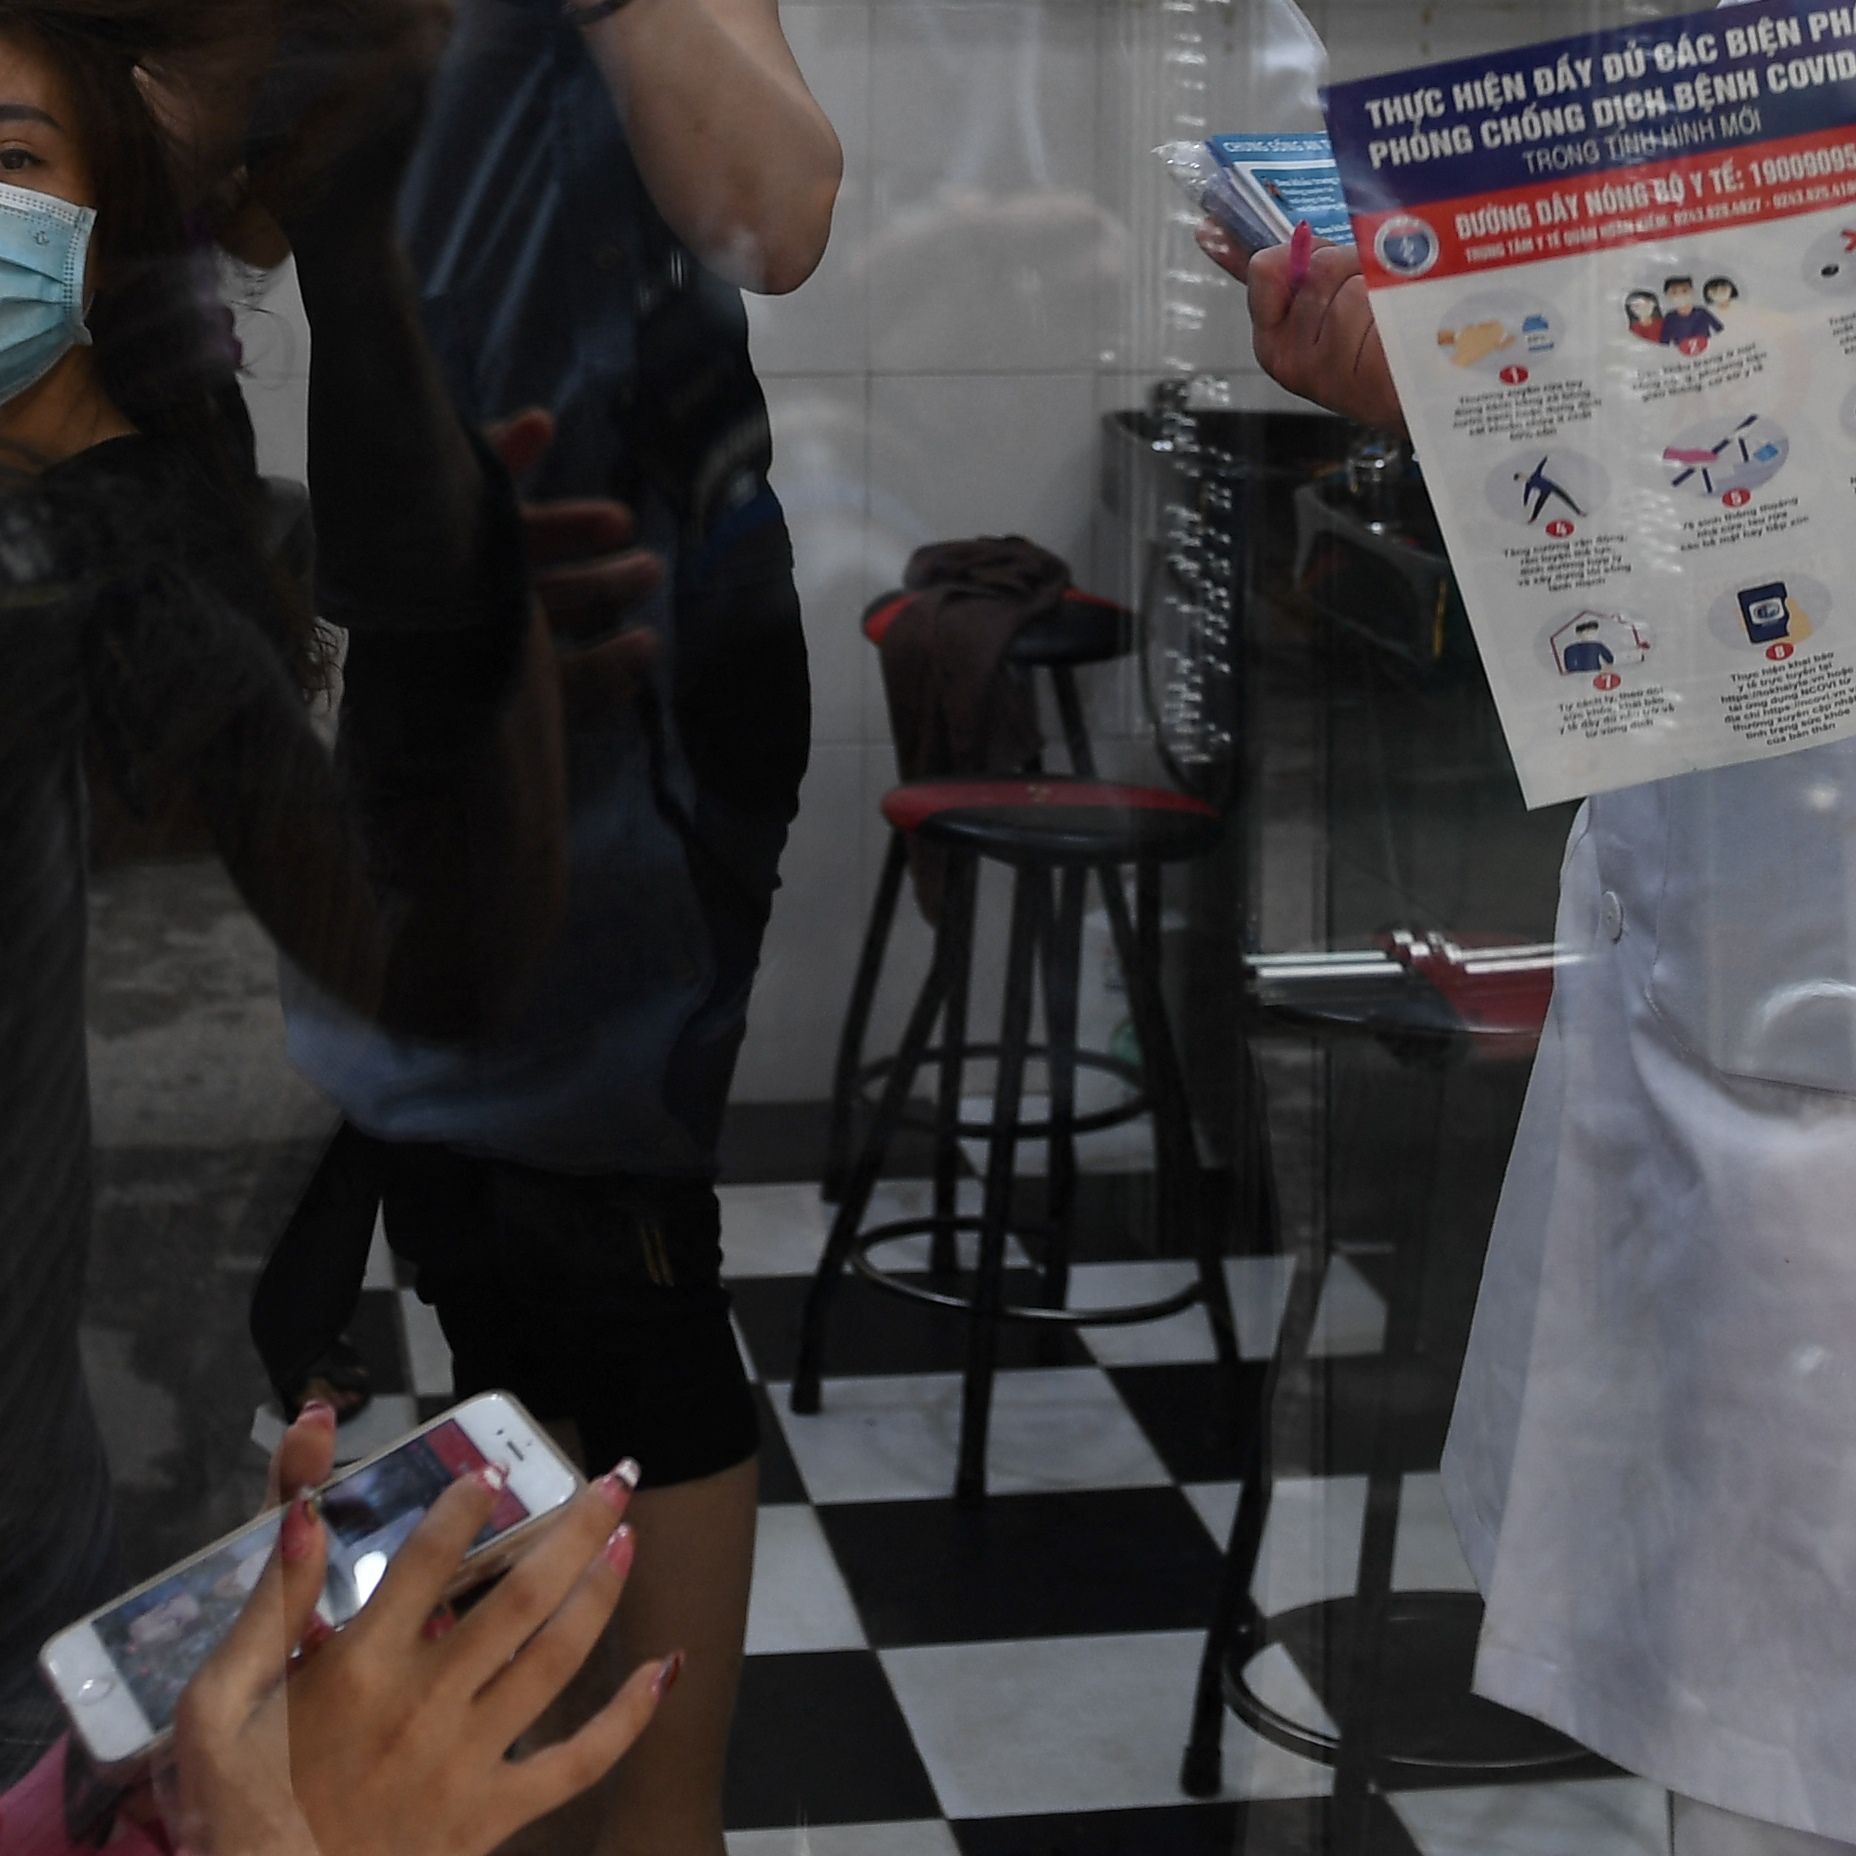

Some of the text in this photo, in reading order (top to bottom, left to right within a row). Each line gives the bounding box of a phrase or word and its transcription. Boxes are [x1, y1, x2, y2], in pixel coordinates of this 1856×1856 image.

[1365, 89, 1444, 128] THỰC
[1452, 72, 1526, 111] HIỆN
[1652, 34, 1717, 71] CÁC
[1726, 17, 1801, 57] BIỆN
[1481, 103, 1585, 147] CHỐNG
[1593, 89, 1667, 128] DỊCH
[1674, 69, 1758, 112] BỆNH
[1523, 139, 1600, 172] TRONG
[1720, 106, 1761, 137] MỚI
[1455, 204, 1532, 239] ĐƯỜNG
[1535, 192, 1578, 225] DÂY
[1585, 177, 1649, 216] NÓNG
[1649, 173, 1685, 206] BỘ
[1689, 171, 1703, 198] Y
